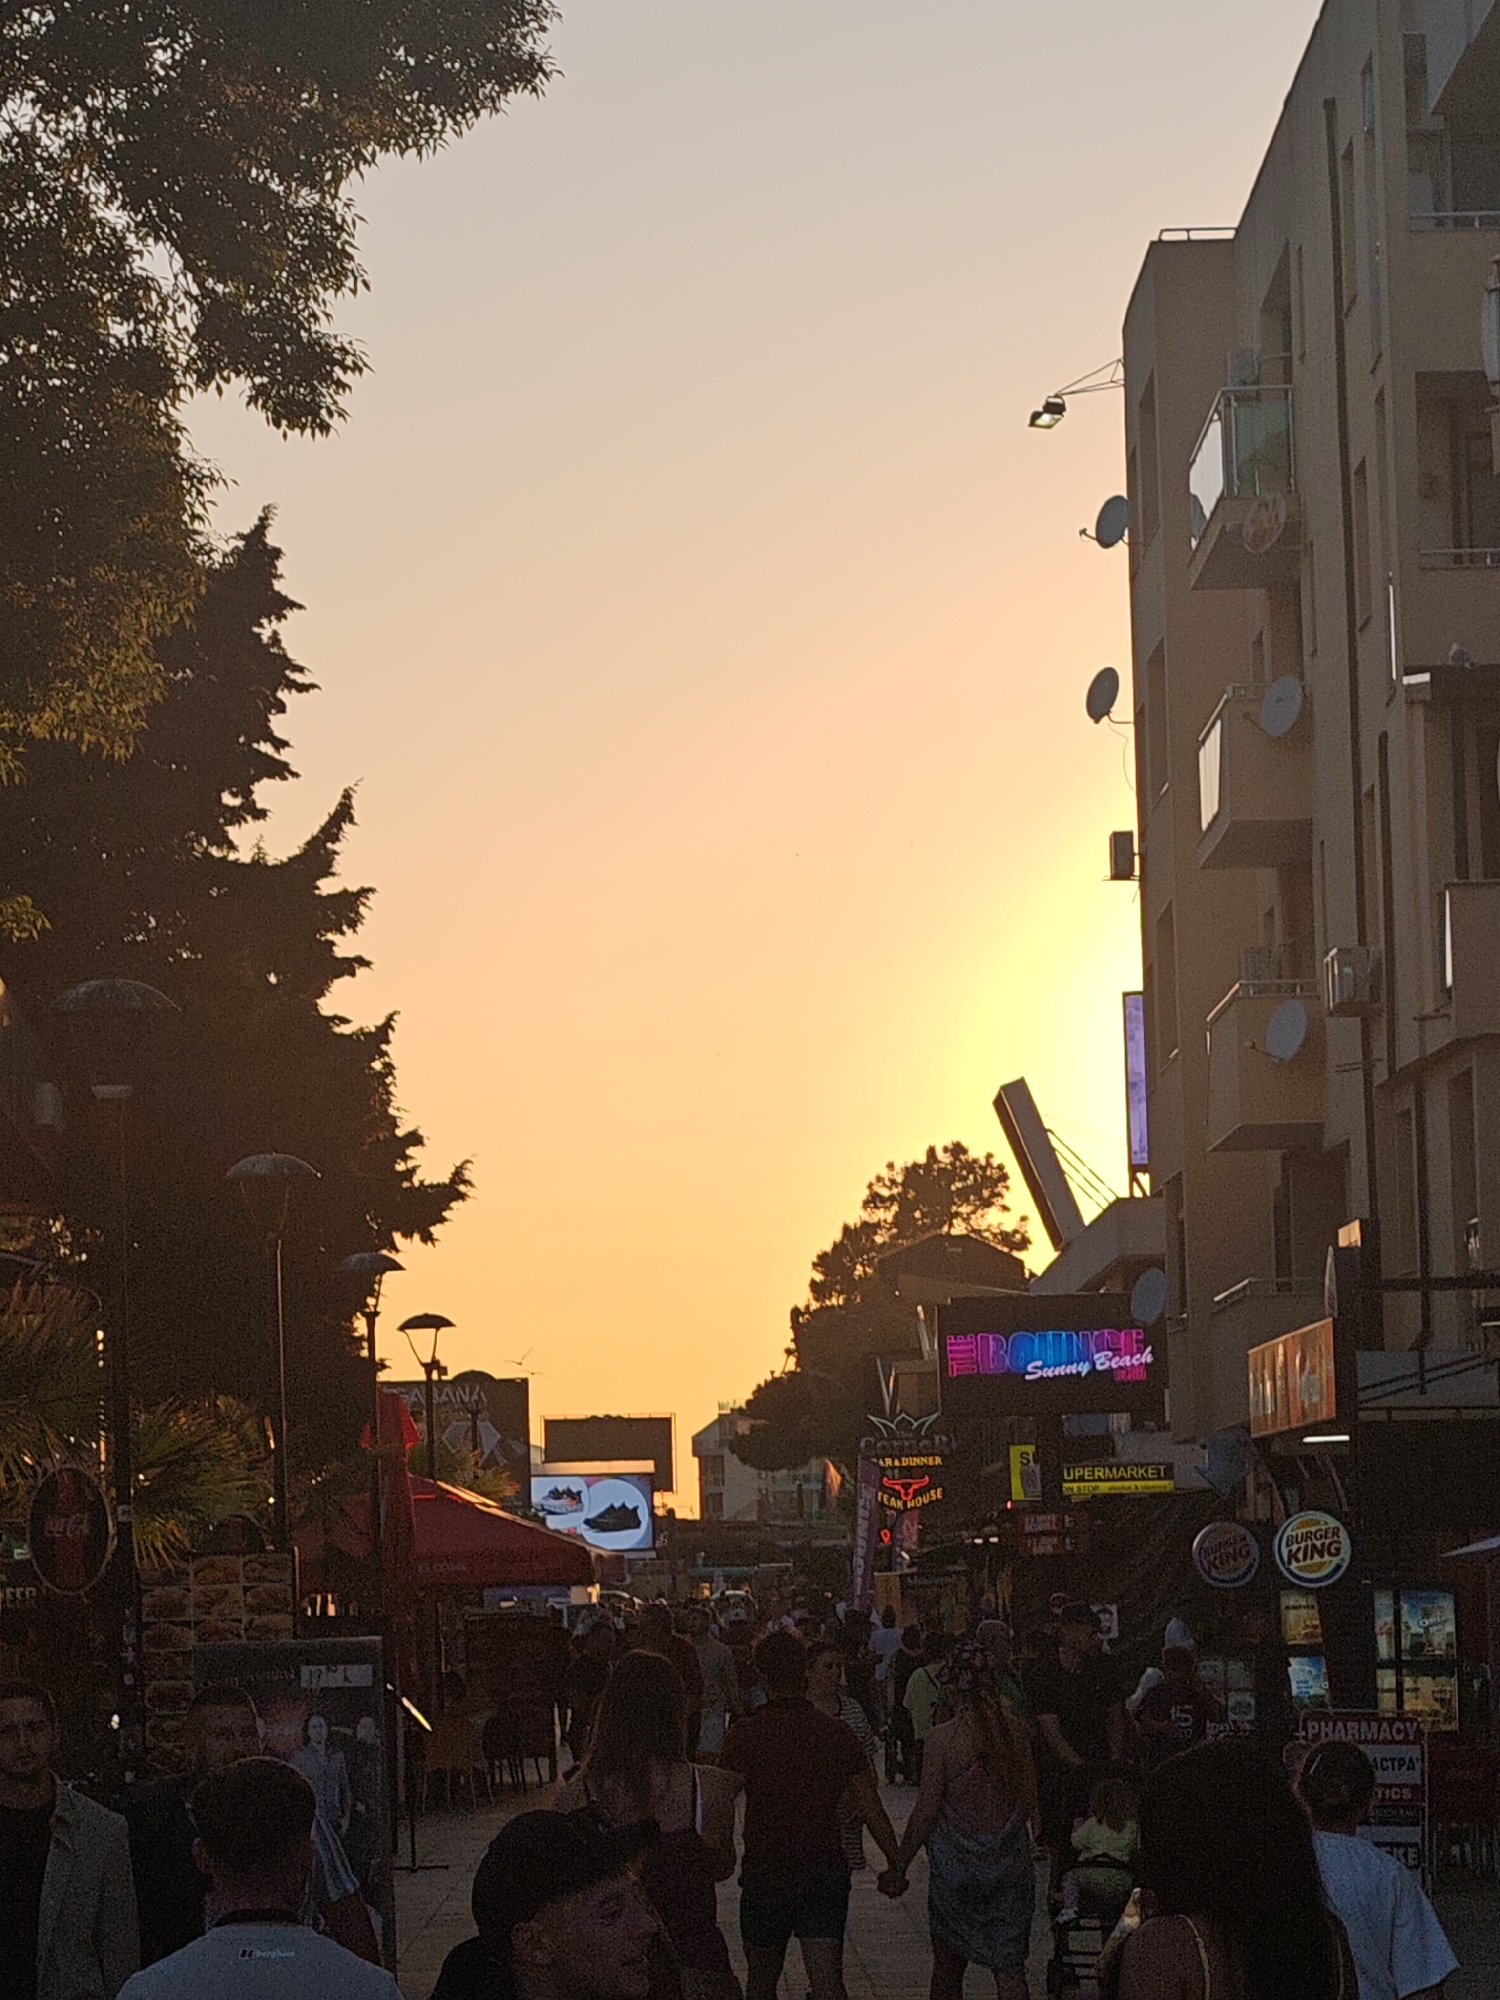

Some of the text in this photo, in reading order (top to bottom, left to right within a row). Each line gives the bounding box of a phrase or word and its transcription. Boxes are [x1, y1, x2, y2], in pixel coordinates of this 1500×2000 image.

[977, 1329, 1145, 1374] BOUNCE
[1024, 1345, 1154, 1380] Sunny Beach
[1063, 1465, 1167, 1480] UPERMARKET
[877, 1488, 943, 1510] TEAK HOUSE
[1285, 1526, 1341, 1548] BURGER
[1206, 1543, 1251, 1571] KING
[1286, 1540, 1342, 1565] KING
[1307, 1720, 1418, 1741] PHARMACY
[1376, 1787, 1412, 1800] TICS
